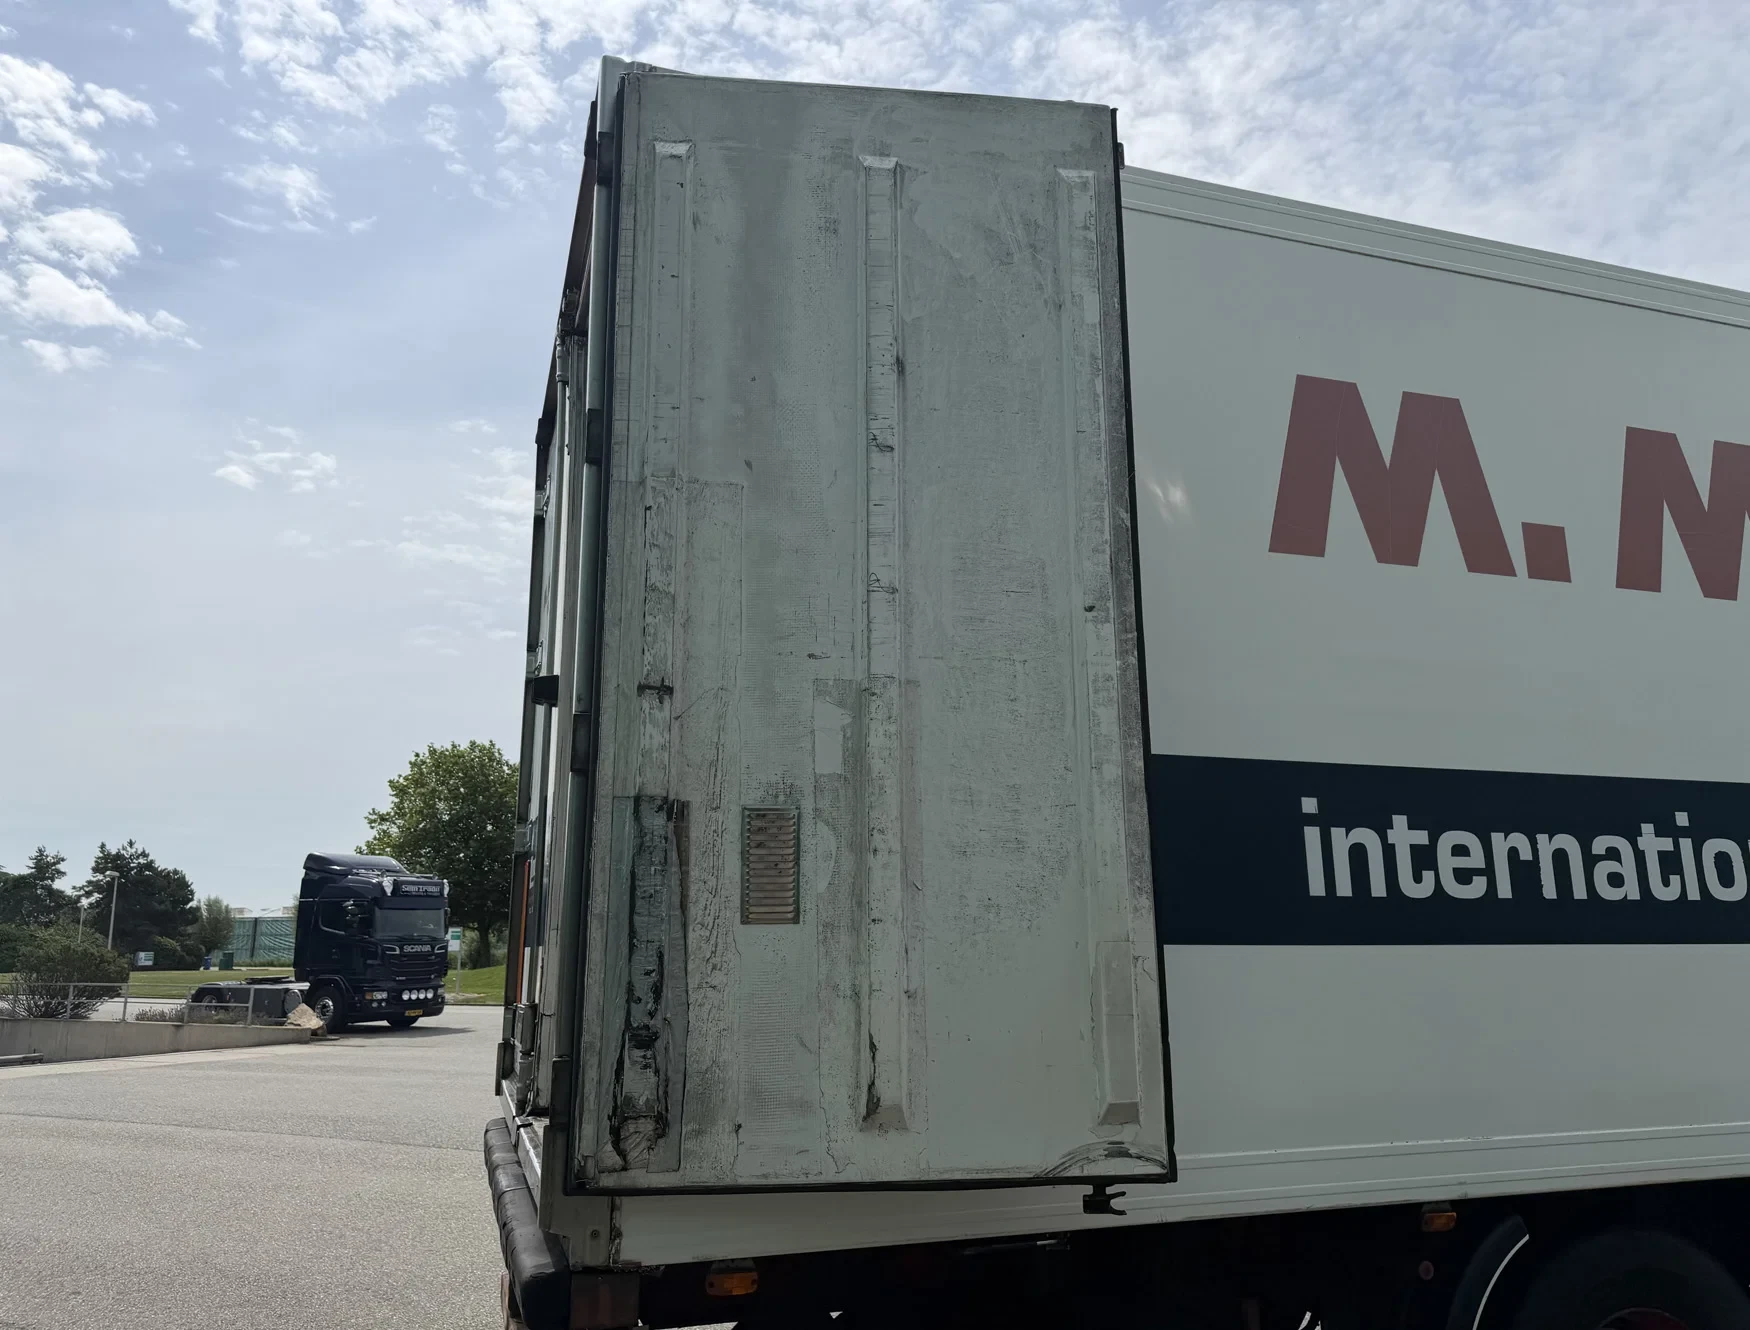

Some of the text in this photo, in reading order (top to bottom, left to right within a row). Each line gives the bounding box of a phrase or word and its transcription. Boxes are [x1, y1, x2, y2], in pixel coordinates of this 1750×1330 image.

[1268, 374, 1572, 583] M.
[1301, 797, 1750, 902] internatio
[403, 944, 432, 952] SCANIA
